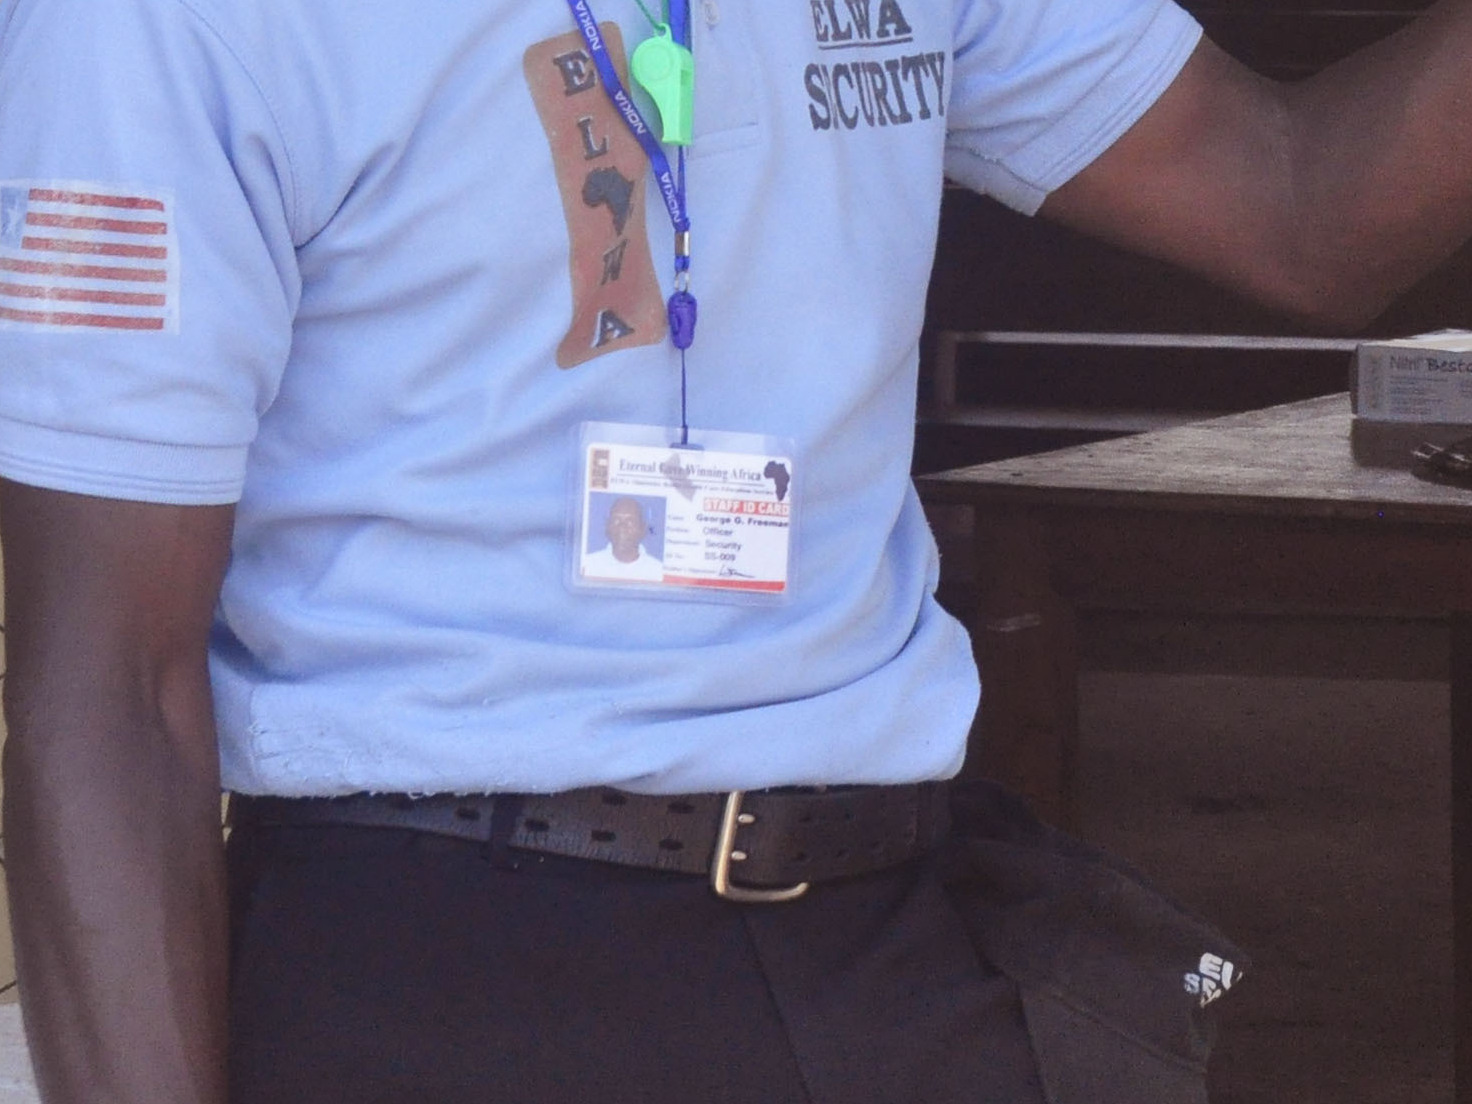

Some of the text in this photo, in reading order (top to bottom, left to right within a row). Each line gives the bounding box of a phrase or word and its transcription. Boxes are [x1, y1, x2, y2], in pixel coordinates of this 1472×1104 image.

[575, 0, 602, 51] NOKIA
[614, 90, 647, 135] NOKIA
[660, 171, 682, 224] NOKIA
[619, 459, 657, 473] Eternal
[685, 463, 728, 479] Winning
[732, 468, 761, 481] Africa
[704, 498, 788, 516] STAFF ID CARD
[696, 513, 731, 525] George
[747, 517, 789, 527] Freeman
[703, 526, 733, 536] Officer
[704, 539, 742, 551] Security
